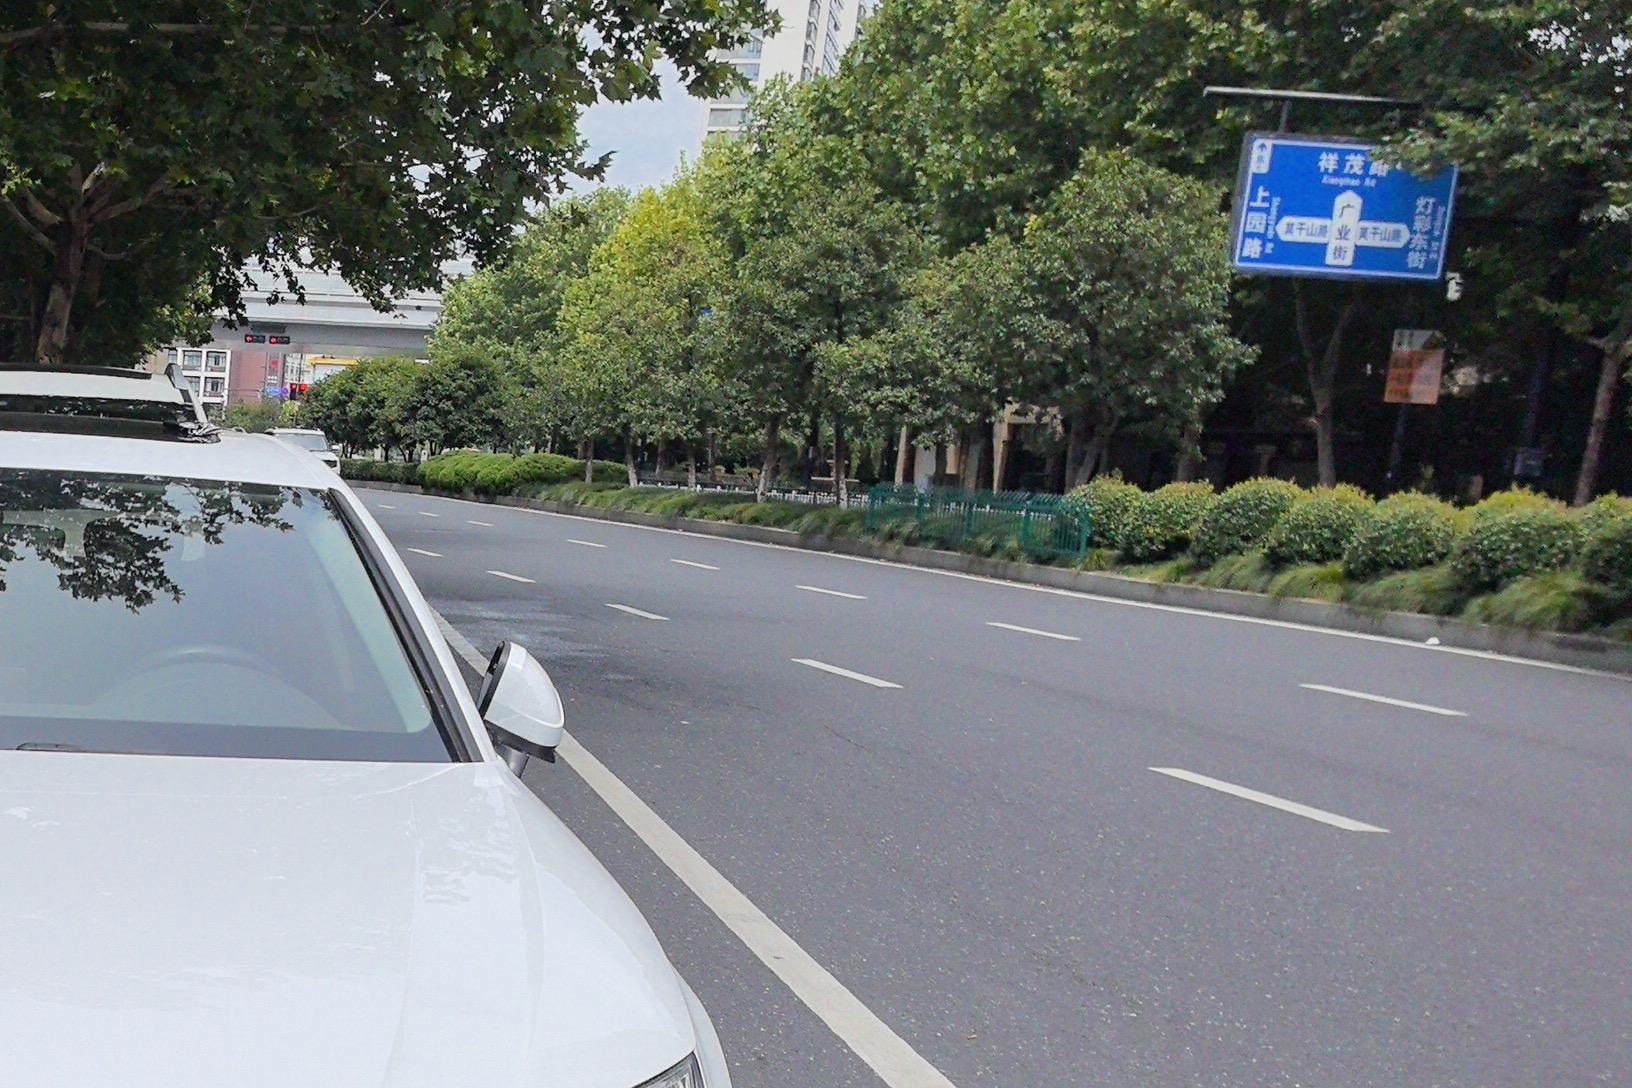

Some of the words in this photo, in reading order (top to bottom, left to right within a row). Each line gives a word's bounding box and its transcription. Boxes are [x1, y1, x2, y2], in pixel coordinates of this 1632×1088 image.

[1318, 151, 1390, 177] 祥茂路
[1242, 186, 1270, 259] 上园路
[1332, 203, 1356, 261] 广业街
